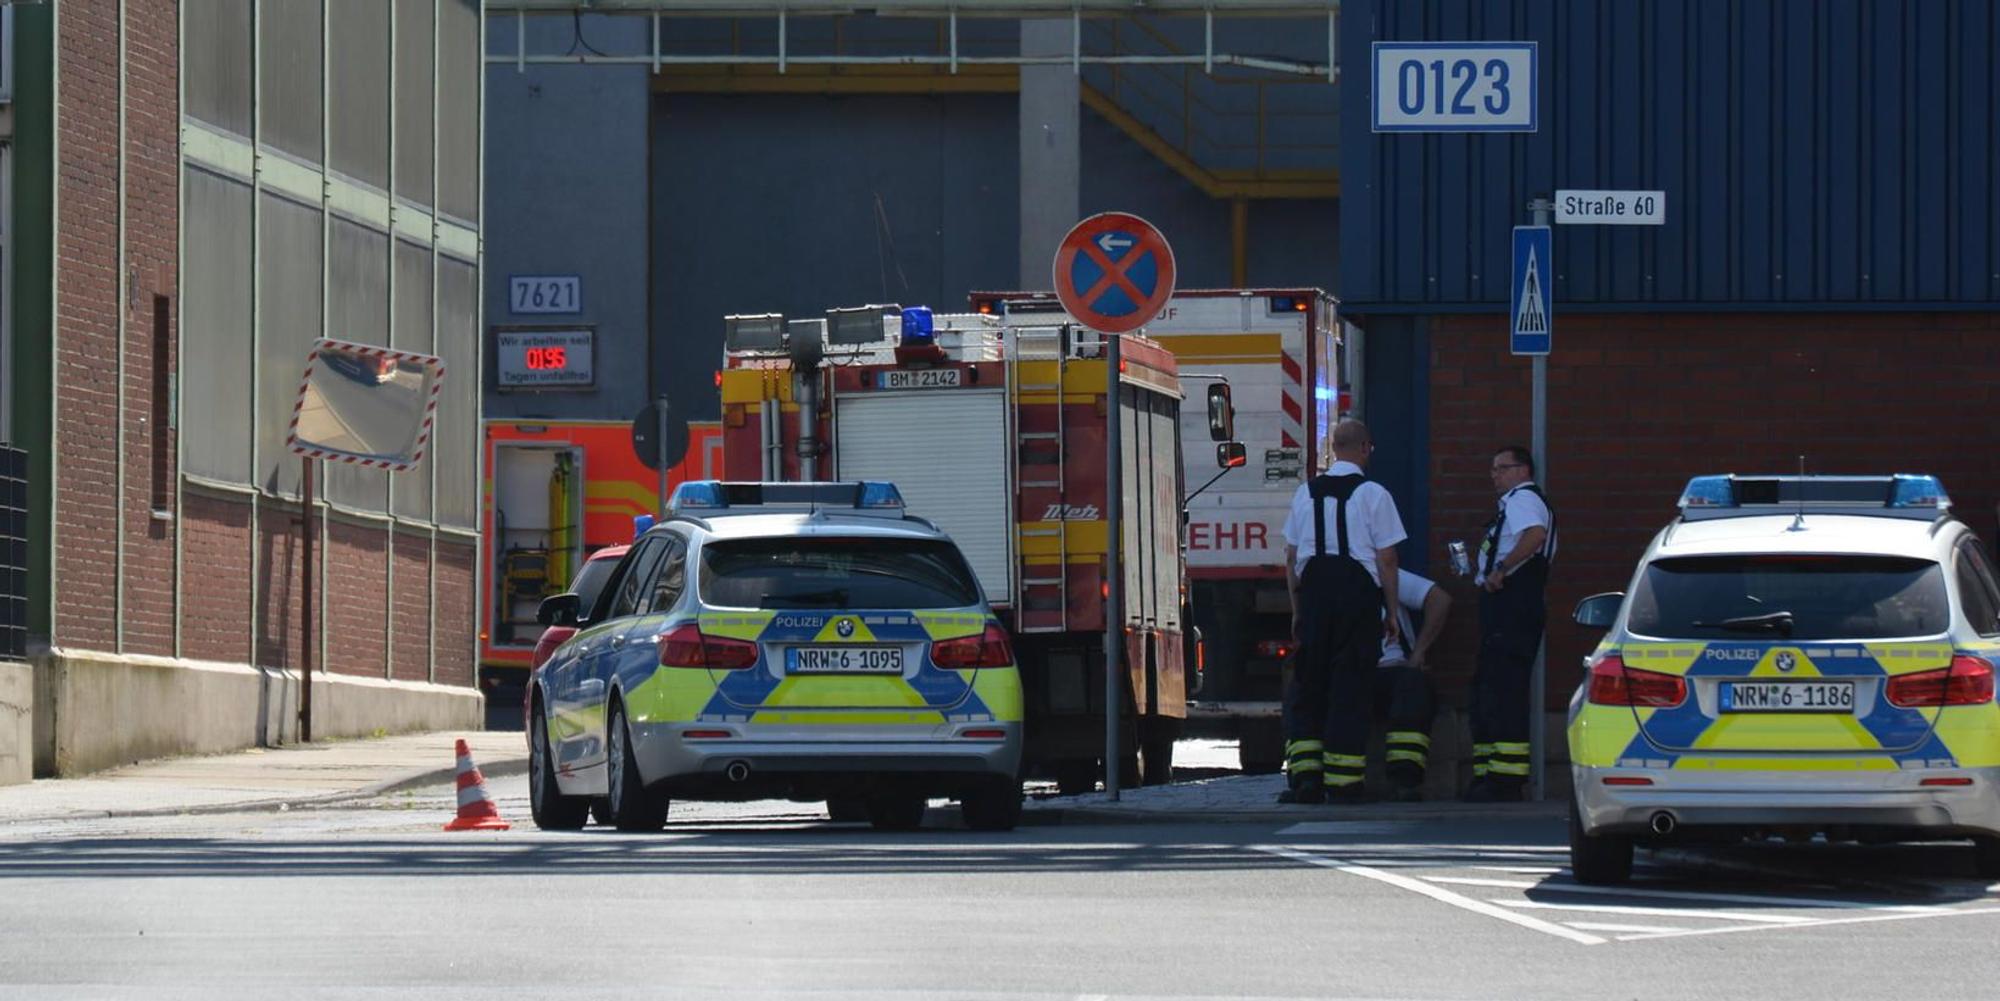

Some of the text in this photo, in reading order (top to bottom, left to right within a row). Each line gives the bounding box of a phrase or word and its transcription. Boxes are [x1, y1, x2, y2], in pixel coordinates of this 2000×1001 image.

[1398, 59, 1511, 115] 0123
[1565, 196, 1655, 216] Straße 60
[517, 282, 574, 308] 7621
[1156, 307, 1178, 320] UF
[500, 335, 591, 346] Wir arbeiten seit
[504, 370, 589, 384] Tagen unfallfrei
[889, 370, 956, 387] BM 2142
[1042, 504, 1100, 521] Metz
[1189, 522, 1268, 549] EHR
[775, 616, 823, 628] POLIZEI
[797, 650, 901, 669] NRW 6-1095
[1706, 648, 1760, 661] POLIZEI
[1732, 685, 1852, 706] NRW 6-1186
